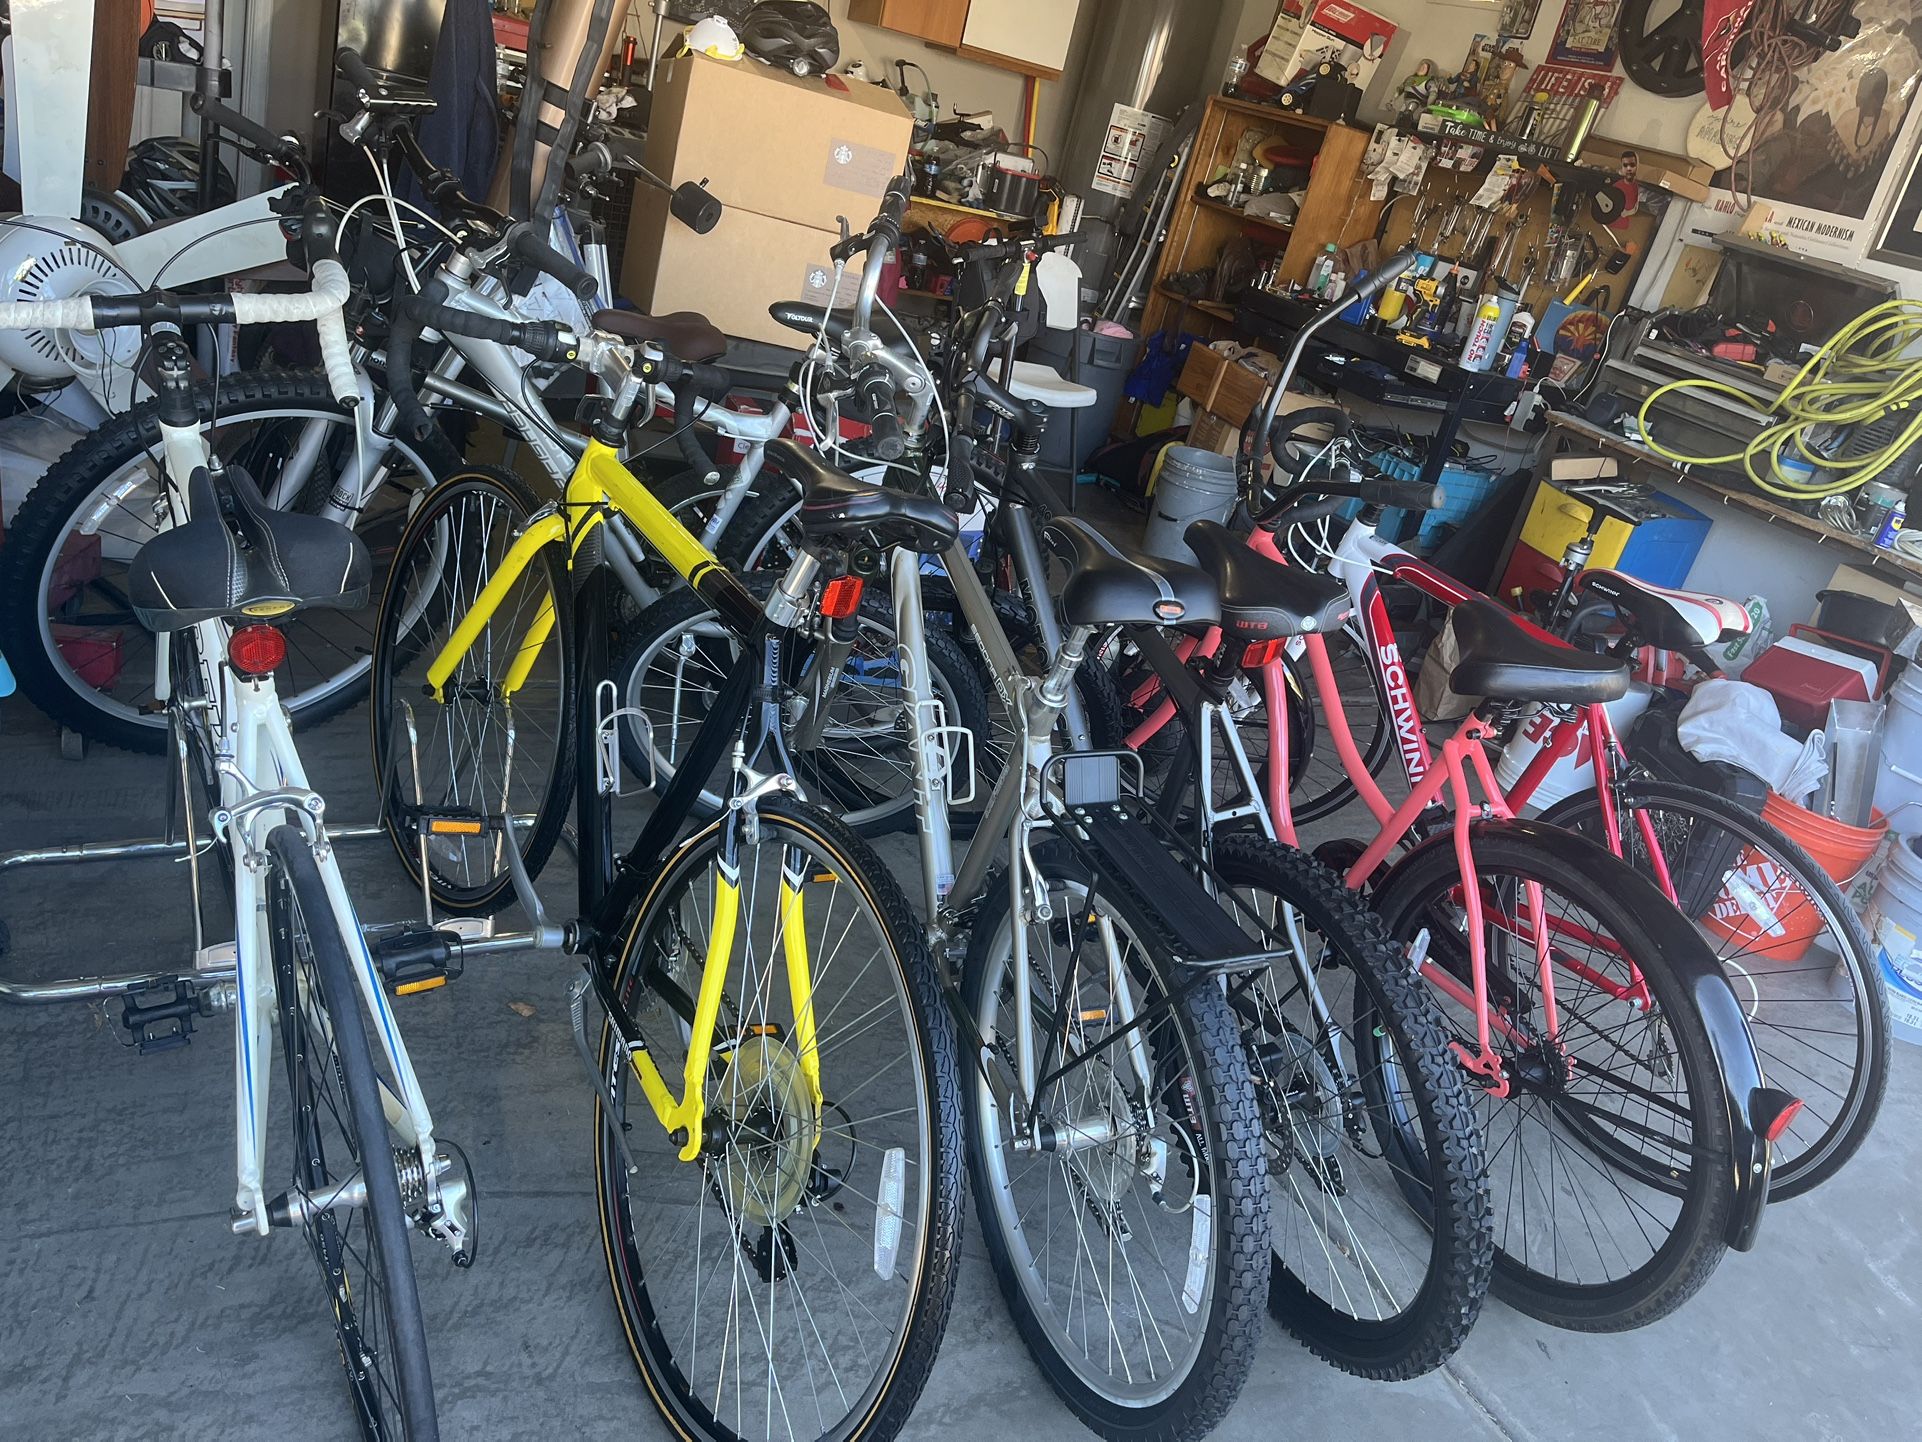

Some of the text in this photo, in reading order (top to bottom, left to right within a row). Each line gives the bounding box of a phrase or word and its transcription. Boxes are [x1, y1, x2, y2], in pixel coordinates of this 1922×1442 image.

[1533, 70, 1573, 93] LIFE
[1444, 122, 1467, 138] Take
[1469, 128, 1488, 143] TIME
[1713, 199, 1736, 215] KAHLO
[1785, 216, 1816, 233] MEXICAN
[1815, 222, 1855, 242] MODERNISM
[1467, 319, 1487, 362] NO TOUCH
[1591, 581, 1620, 597] SCHWINN
[1751, 607, 1761, 620] 20
[1235, 620, 1269, 630] WTB
